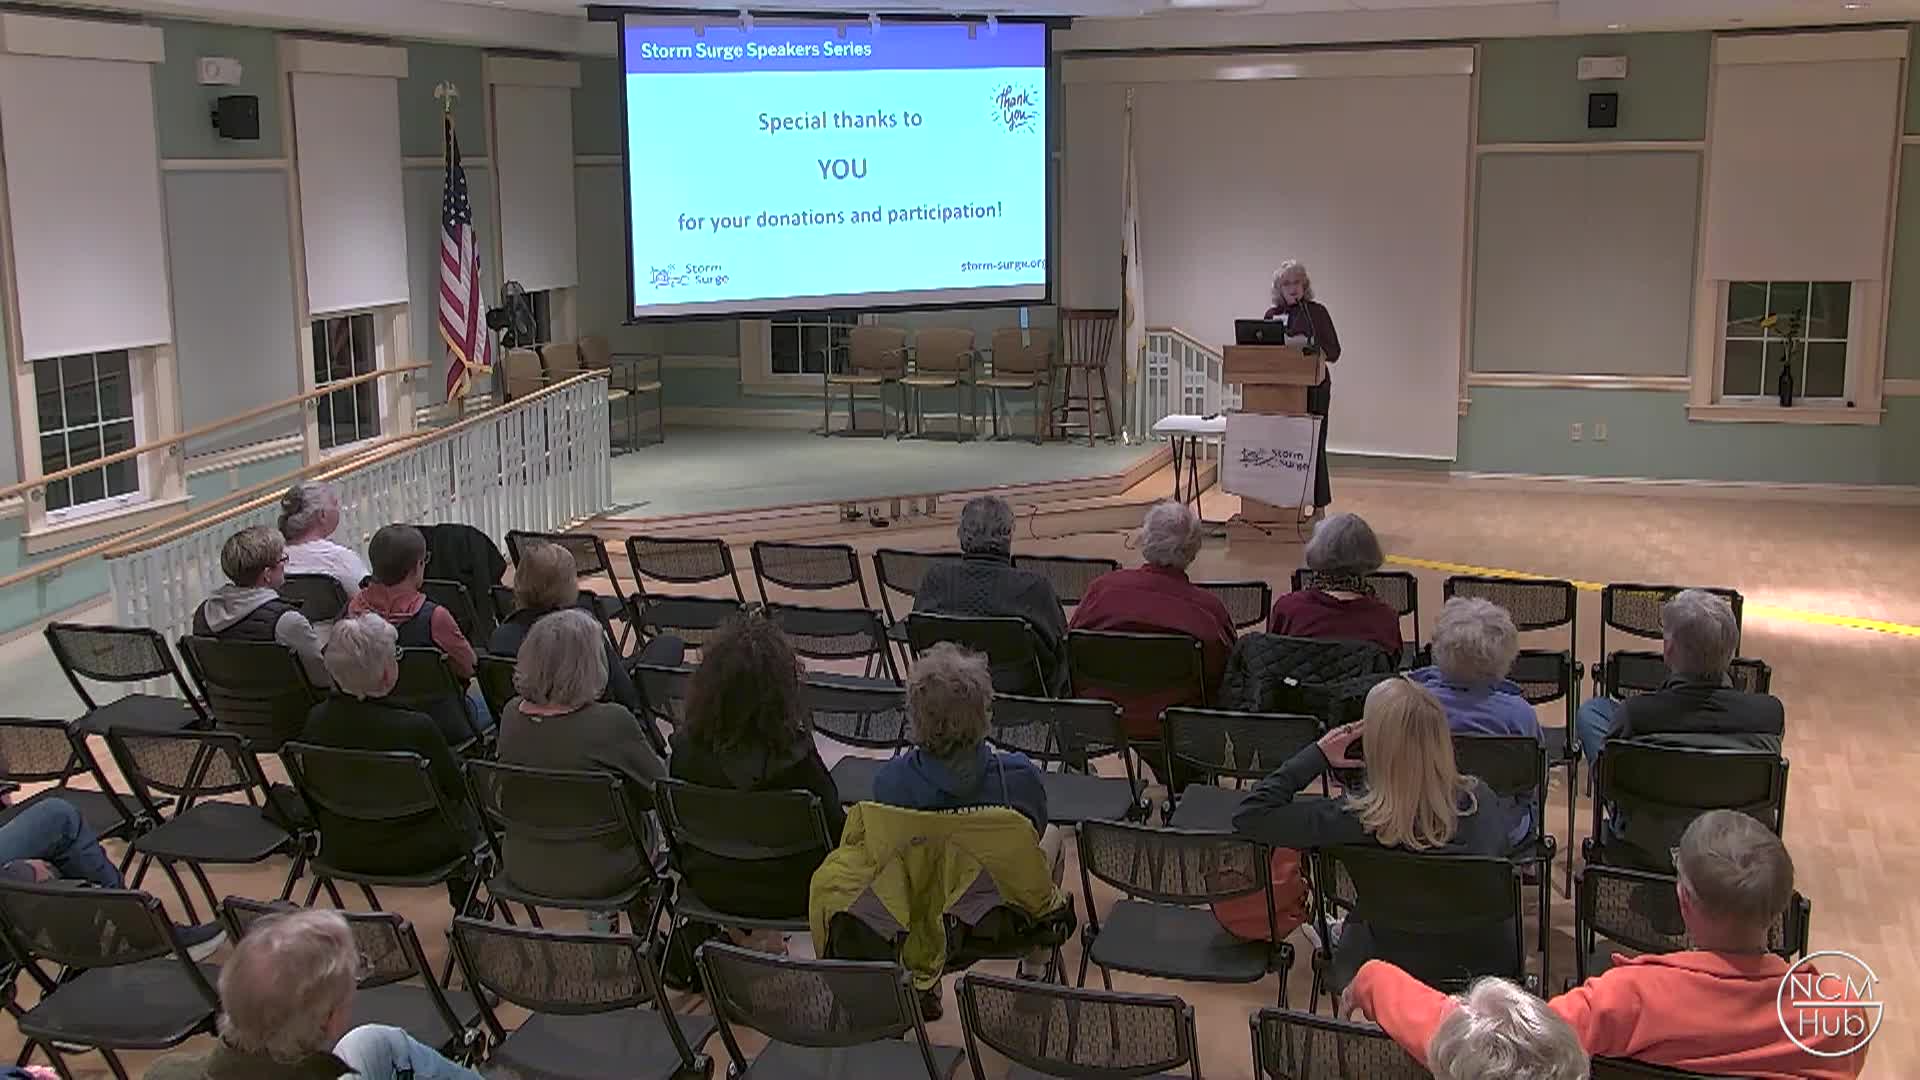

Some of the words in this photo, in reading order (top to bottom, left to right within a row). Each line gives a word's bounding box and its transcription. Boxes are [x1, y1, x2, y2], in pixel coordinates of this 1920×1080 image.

[641, 43, 692, 60] Storm
[695, 42, 743, 60] Surge
[746, 42, 820, 59] Speakers
[823, 41, 872, 57] Series
[758, 112, 827, 135] Special
[833, 109, 897, 128] thanks
[903, 110, 923, 127] to
[818, 158, 867, 180] YOU
[678, 213, 705, 231] for
[710, 215, 751, 234] your
[756, 209, 845, 227] donations
[850, 206, 882, 224] and
[887, 202, 1002, 224] participation!
